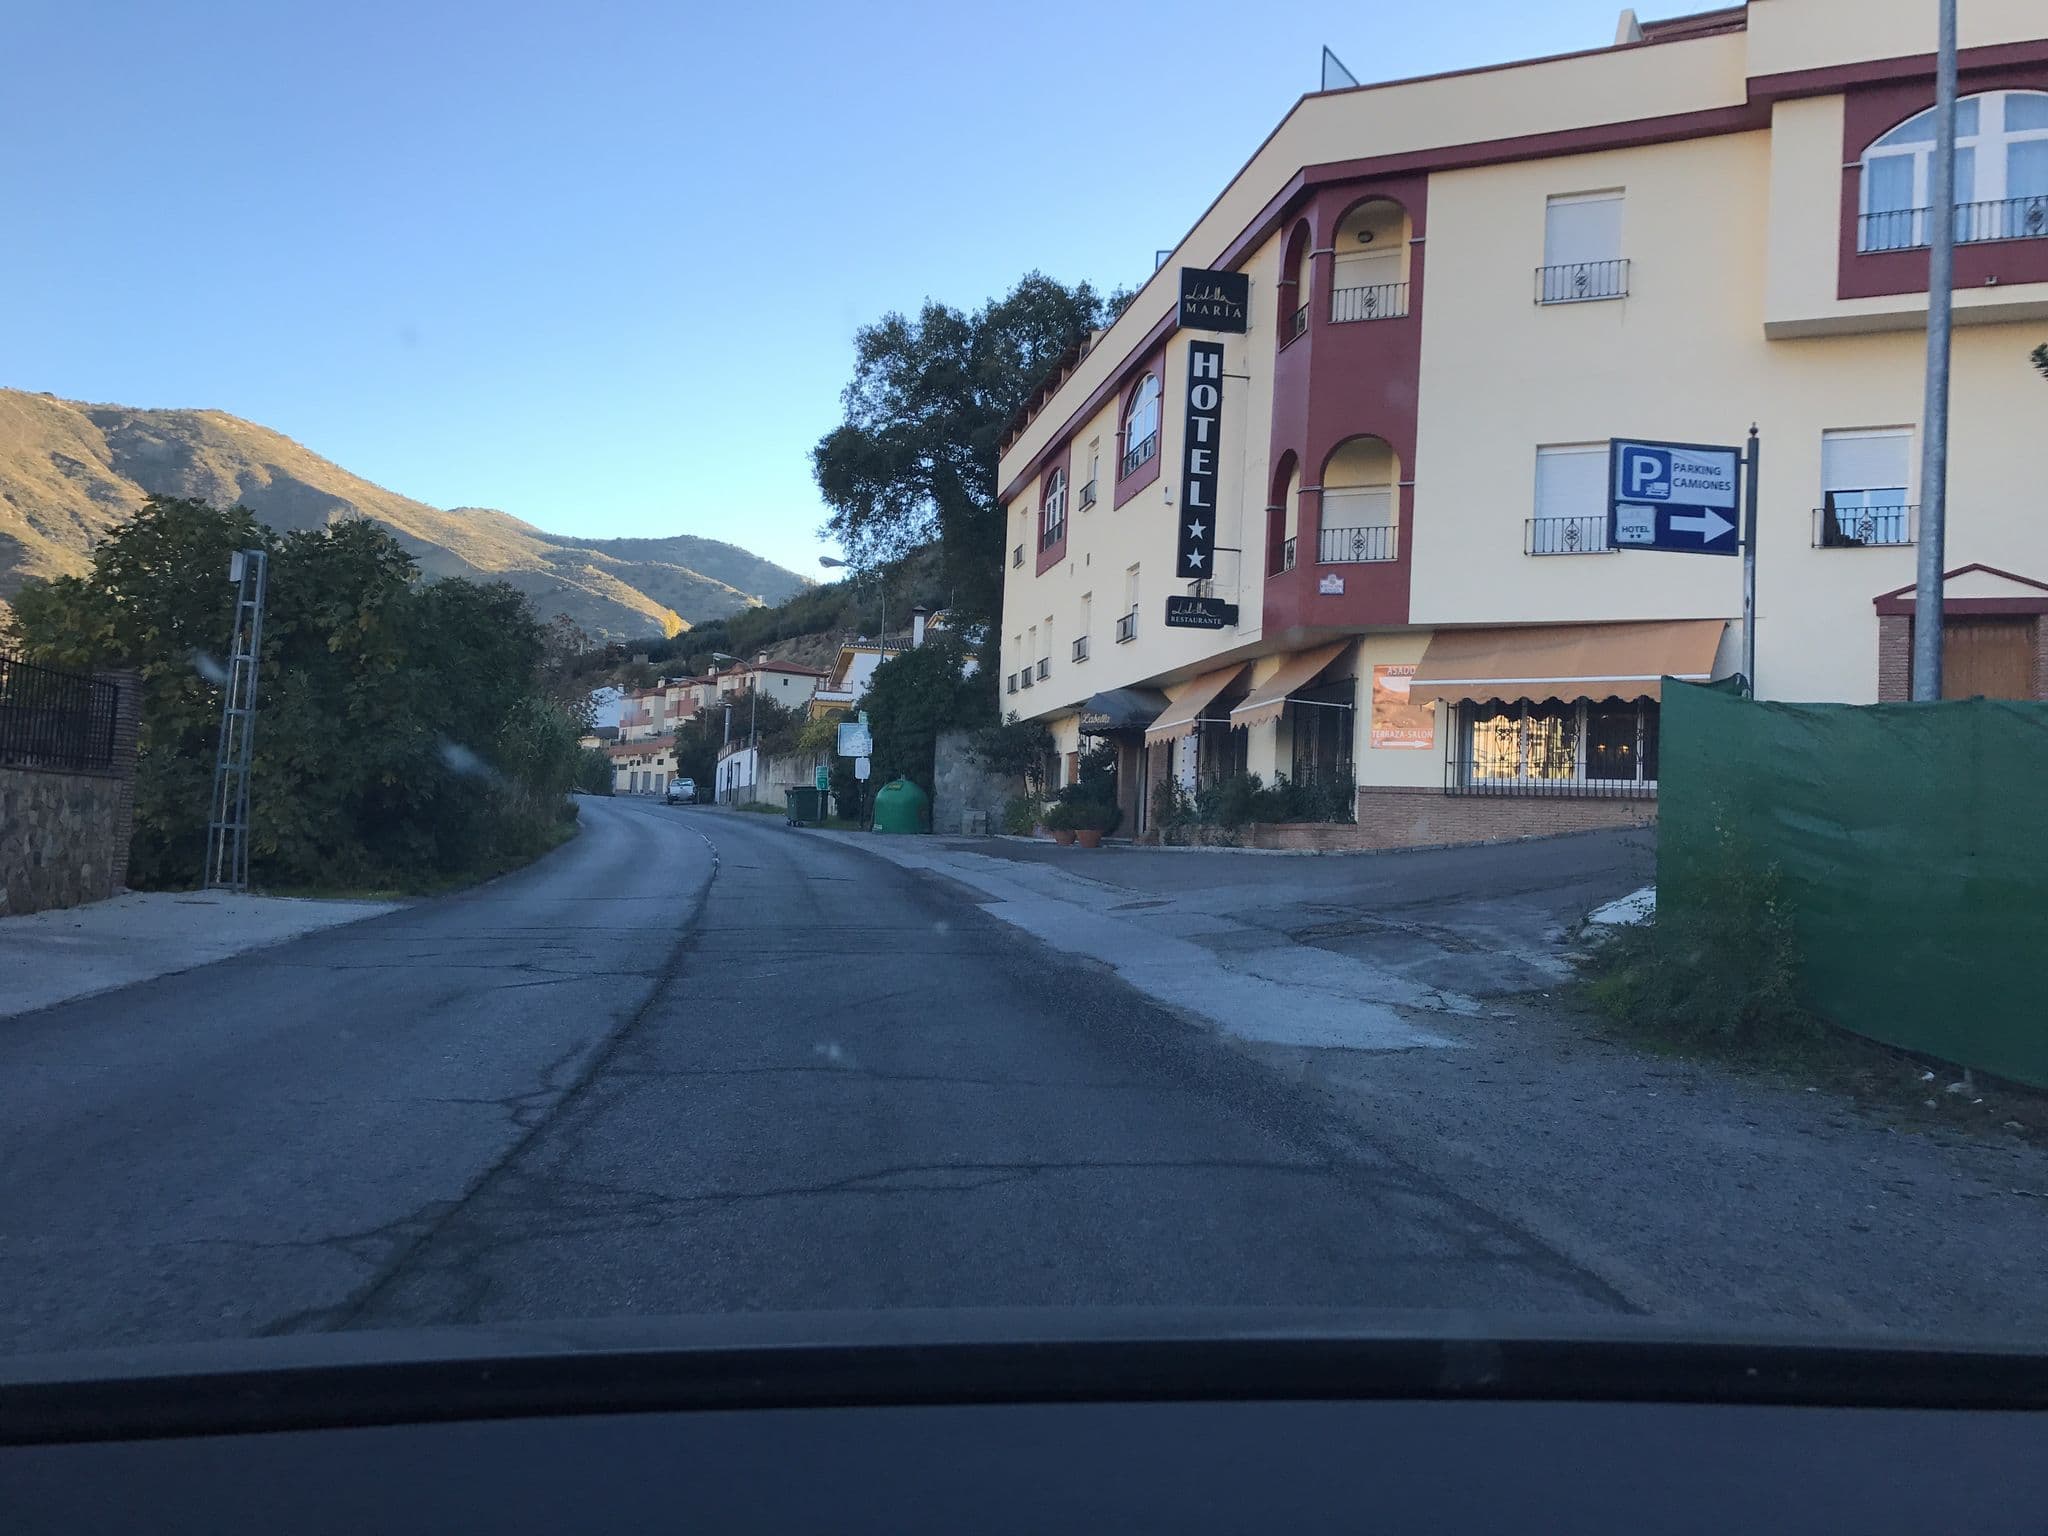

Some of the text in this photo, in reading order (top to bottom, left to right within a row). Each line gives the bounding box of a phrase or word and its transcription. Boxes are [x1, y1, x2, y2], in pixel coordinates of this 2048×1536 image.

[1190, 352, 1219, 507] HOTEL
[1632, 455, 1663, 492] P
[1673, 463, 1721, 476] PARKING
[1672, 478, 1732, 491] CAMIONES
[1622, 525, 1650, 533] HOTEL
[1171, 616, 1221, 624] RESTAURANTE
